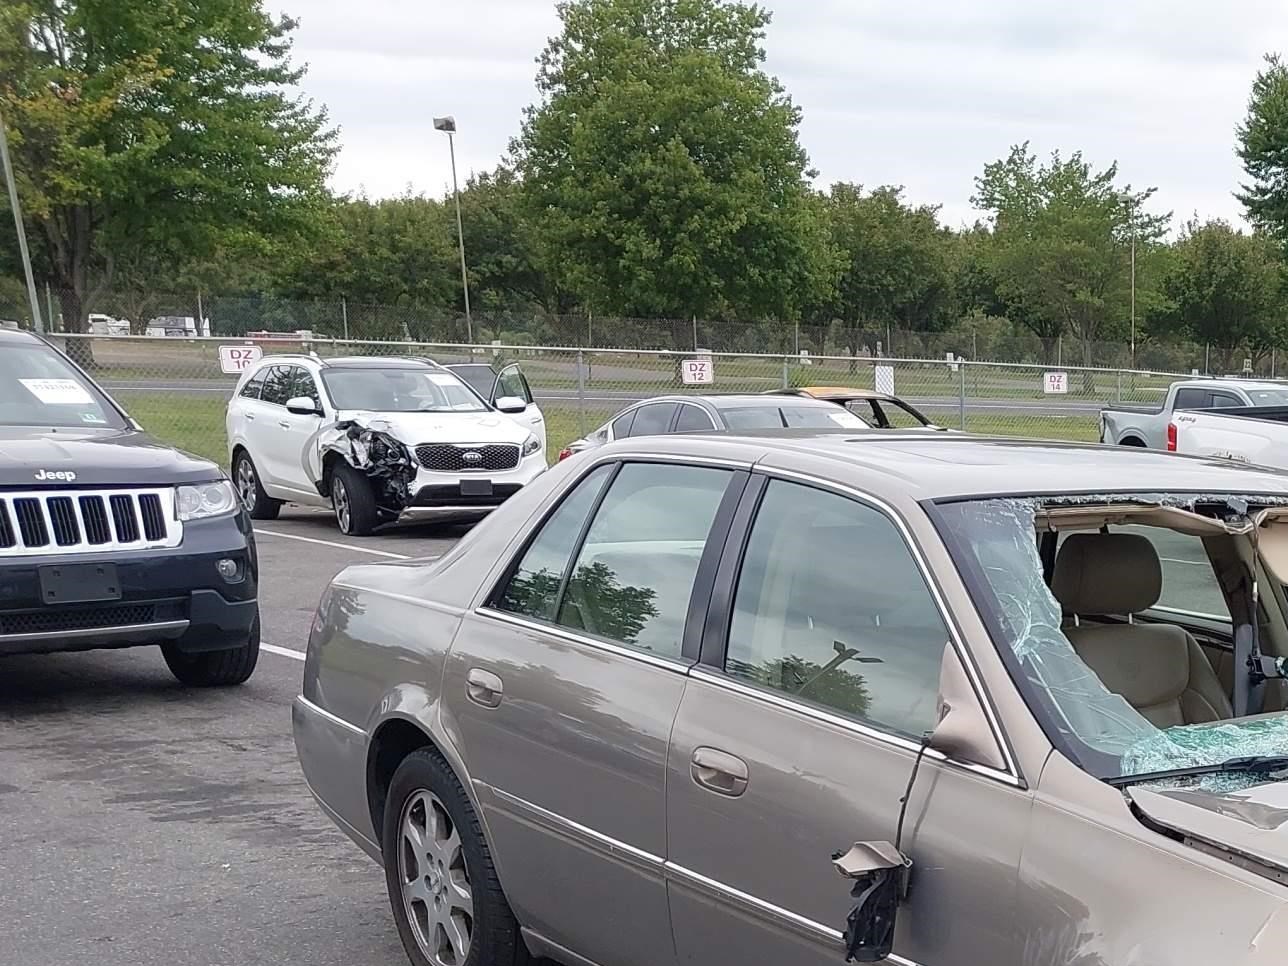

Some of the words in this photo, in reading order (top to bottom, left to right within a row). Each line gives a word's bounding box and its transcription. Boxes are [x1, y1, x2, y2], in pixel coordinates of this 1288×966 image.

[230, 349, 254, 359] DZ
[689, 363, 706, 371] DZ
[693, 373, 705, 381] 12
[1050, 375, 1063, 383] DZ
[34, 469, 77, 482] Jeep
